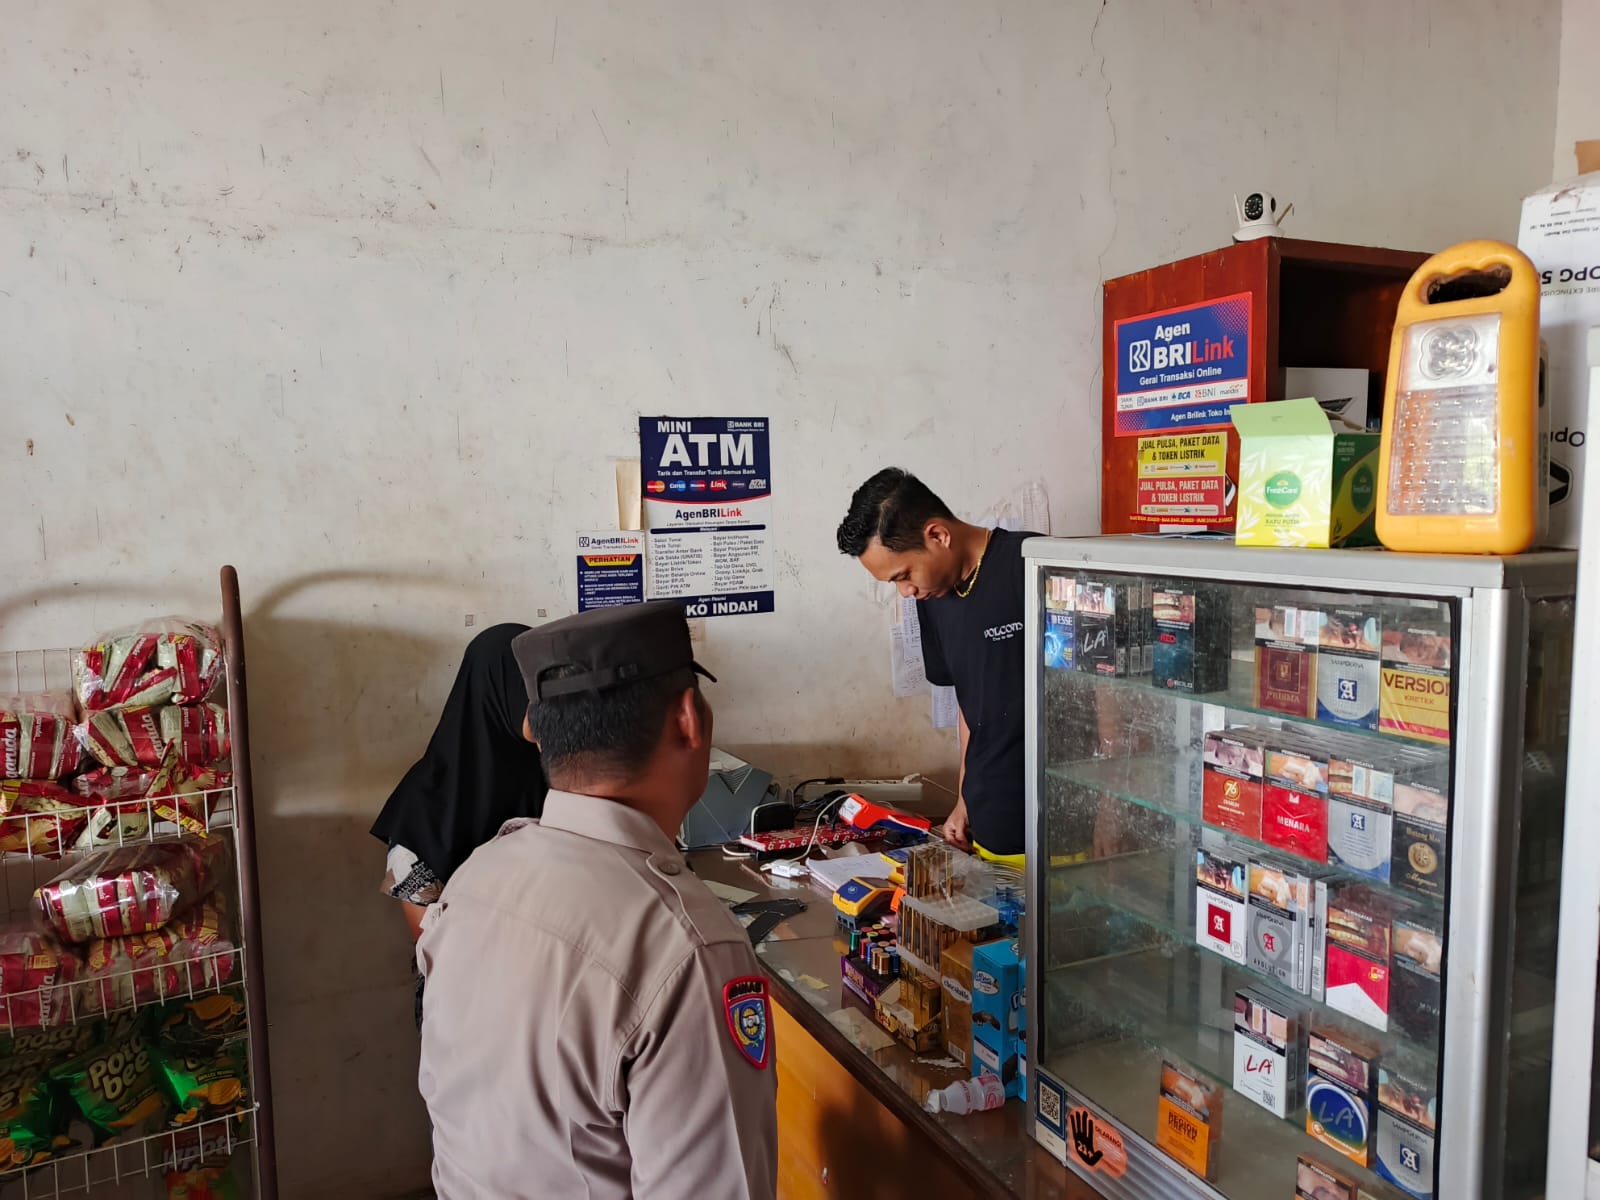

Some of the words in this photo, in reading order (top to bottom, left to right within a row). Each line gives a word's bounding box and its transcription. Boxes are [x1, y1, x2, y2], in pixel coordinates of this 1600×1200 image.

[1154, 323, 1191, 342] Agen
[1153, 335, 1235, 369] BRILink
[1139, 376, 1158, 386] Gerai
[1160, 369, 1195, 383] Transaksi
[1196, 366, 1223, 378] Online
[1177, 391, 1191, 400] BCA
[1201, 388, 1216, 398] BNI
[1170, 413, 1187, 422] Agen
[1208, 409, 1223, 417] Toko
[656, 420, 693, 433] MINI
[1140, 440, 1155, 450] JUAL
[1156, 438, 1178, 448] PULSA,
[1179, 437, 1200, 447] PAKET
[1202, 435, 1220, 445] DATA
[658, 433, 755, 467] ATM
[1158, 451, 1178, 460] TOKEN
[1179, 449, 1206, 459] LISTRIK
[1140, 481, 1154, 491] JUAL
[1155, 480, 1178, 491] PULSA,
[1179, 480, 1199, 490] PAKET
[1201, 479, 1219, 490] DATA
[1157, 493, 1178, 502] TOKEN
[1179, 492, 1205, 502] LISTRIK
[675, 507, 743, 521] AgenBRILink
[591, 535, 639, 545] AgenBRILink
[686, 603, 708, 617] KO
[712, 599, 759, 615] INDAH
[1057, 616, 1073, 626] ESSE
[5, 727, 19, 778] garuda
[1276, 815, 1311, 833] MENARA
